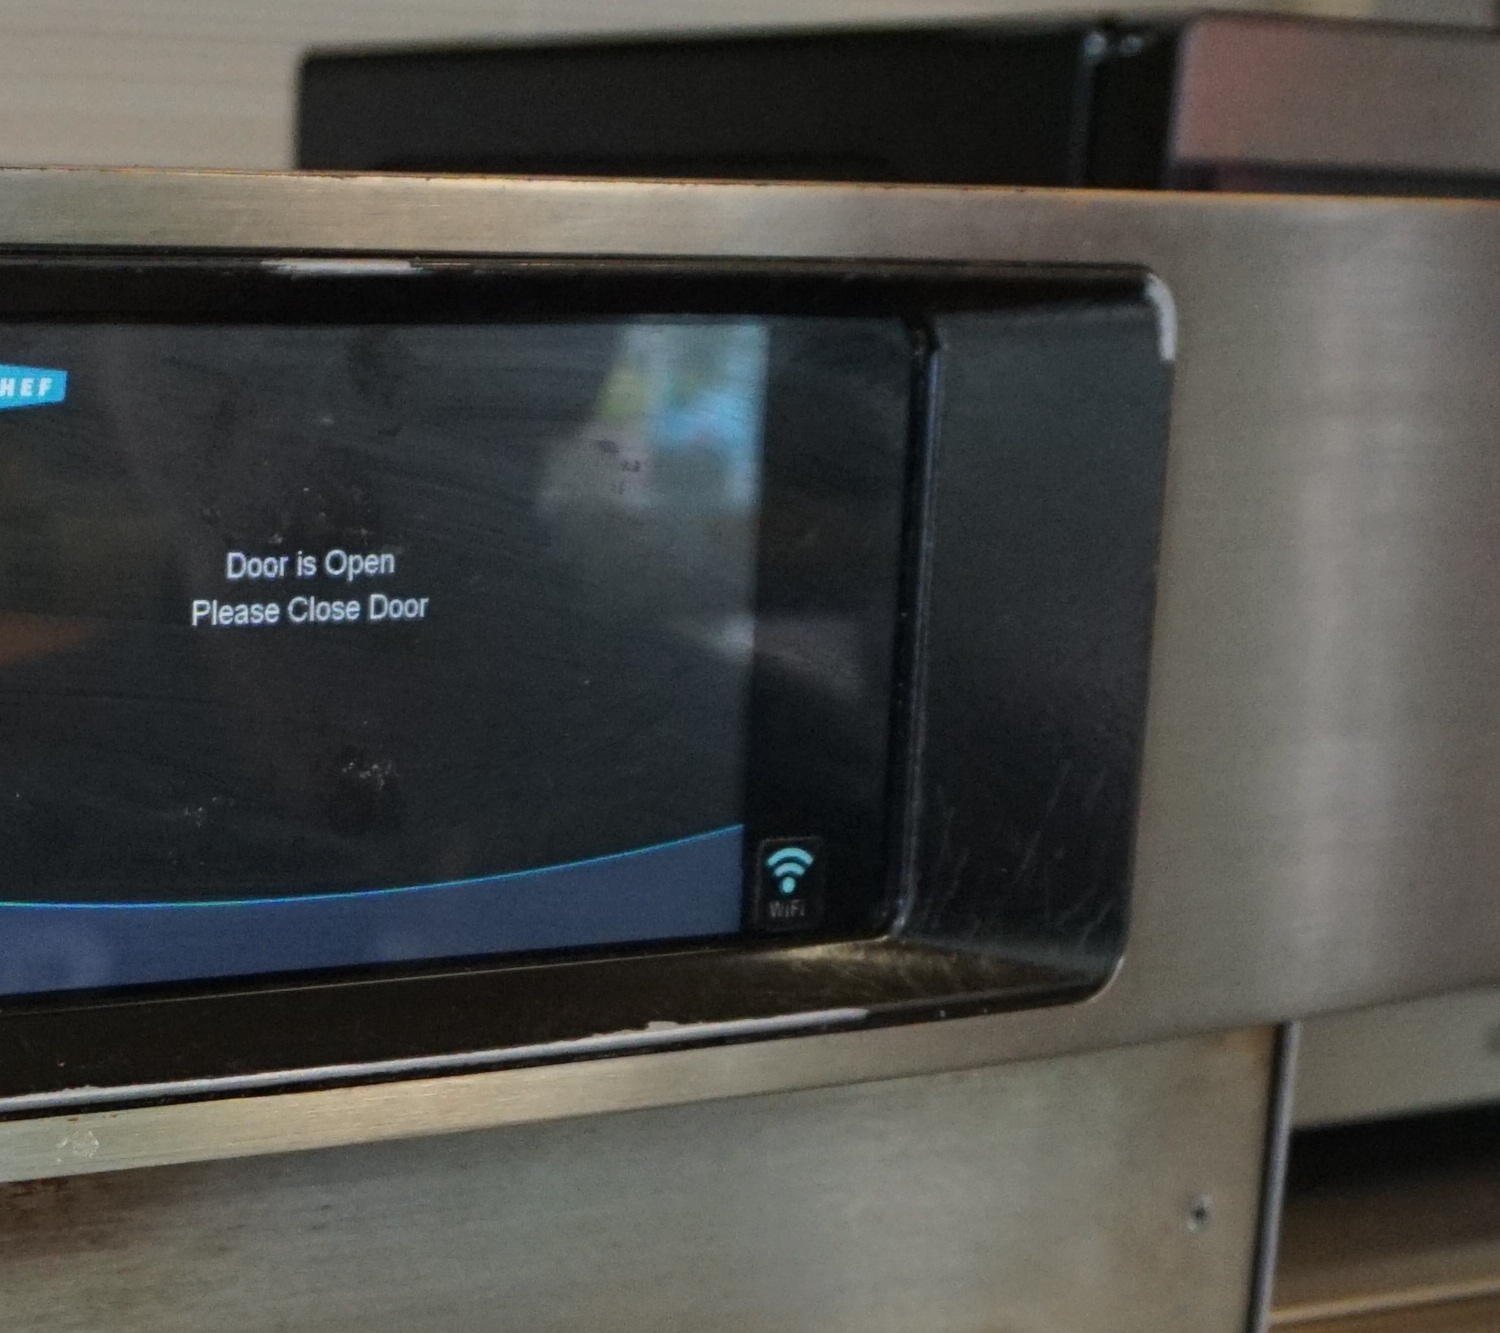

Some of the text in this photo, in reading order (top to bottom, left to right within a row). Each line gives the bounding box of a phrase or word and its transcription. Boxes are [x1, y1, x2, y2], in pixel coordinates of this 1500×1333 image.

[225, 549, 396, 582] Door is Open
[191, 592, 430, 627] Please Close Door
